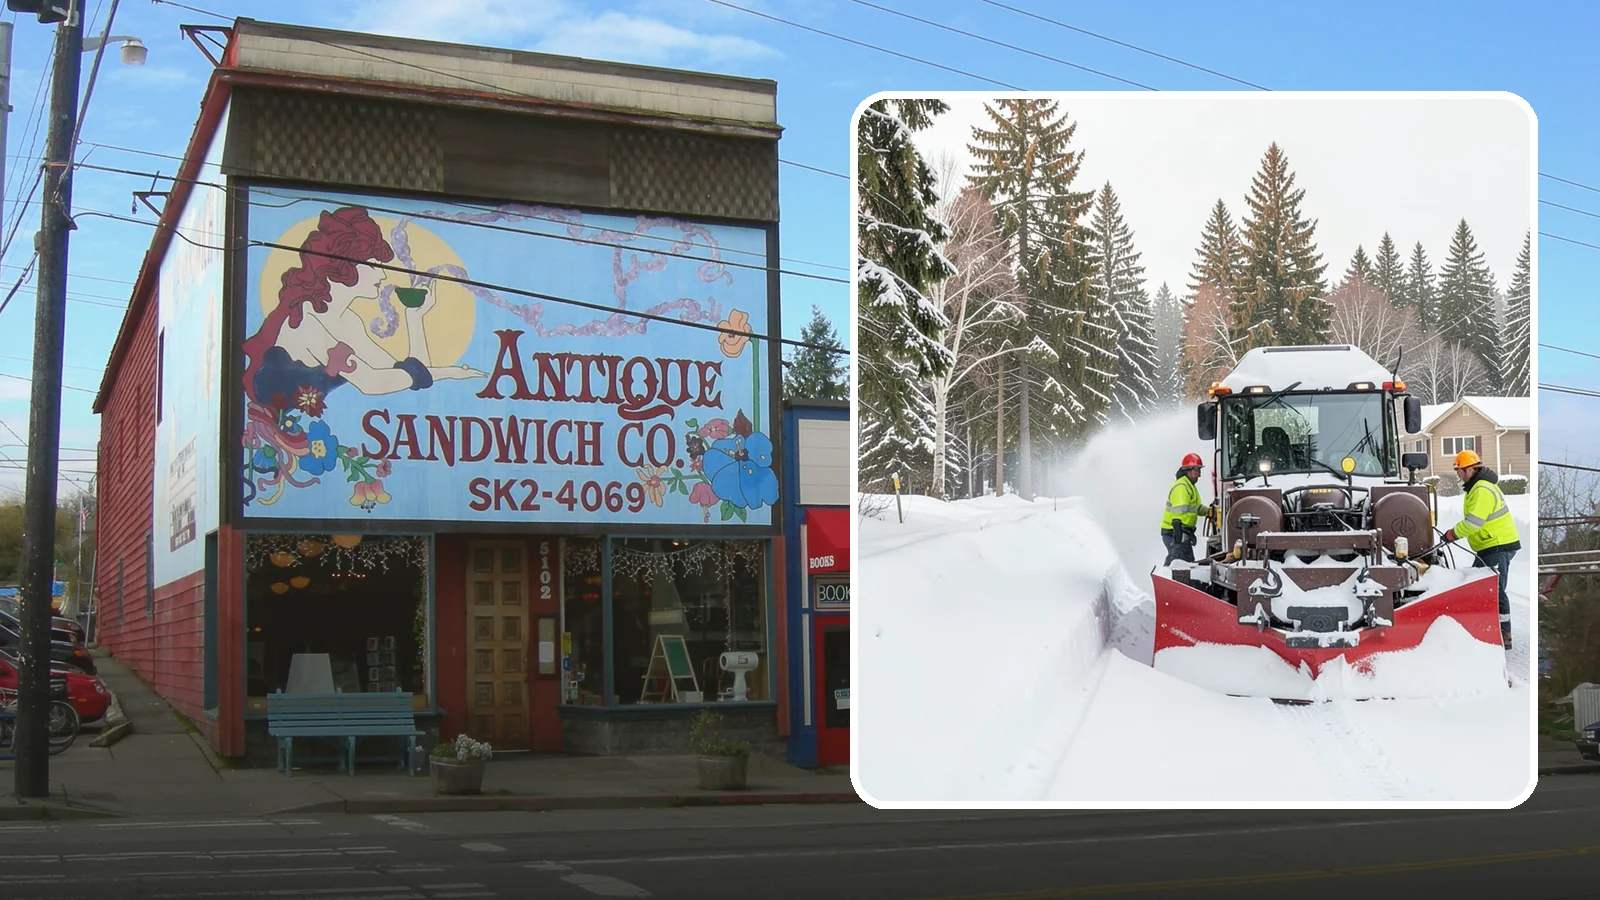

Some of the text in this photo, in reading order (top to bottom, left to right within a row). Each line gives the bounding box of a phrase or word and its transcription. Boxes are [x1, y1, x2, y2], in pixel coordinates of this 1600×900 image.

[476, 329, 723, 420] ANTIQUE
[361, 409, 685, 469] SANDWICH CO.
[469, 477, 645, 512] SK2-4069
[540, 542, 551, 599] 5102
[810, 555, 835, 568] BOOKS
